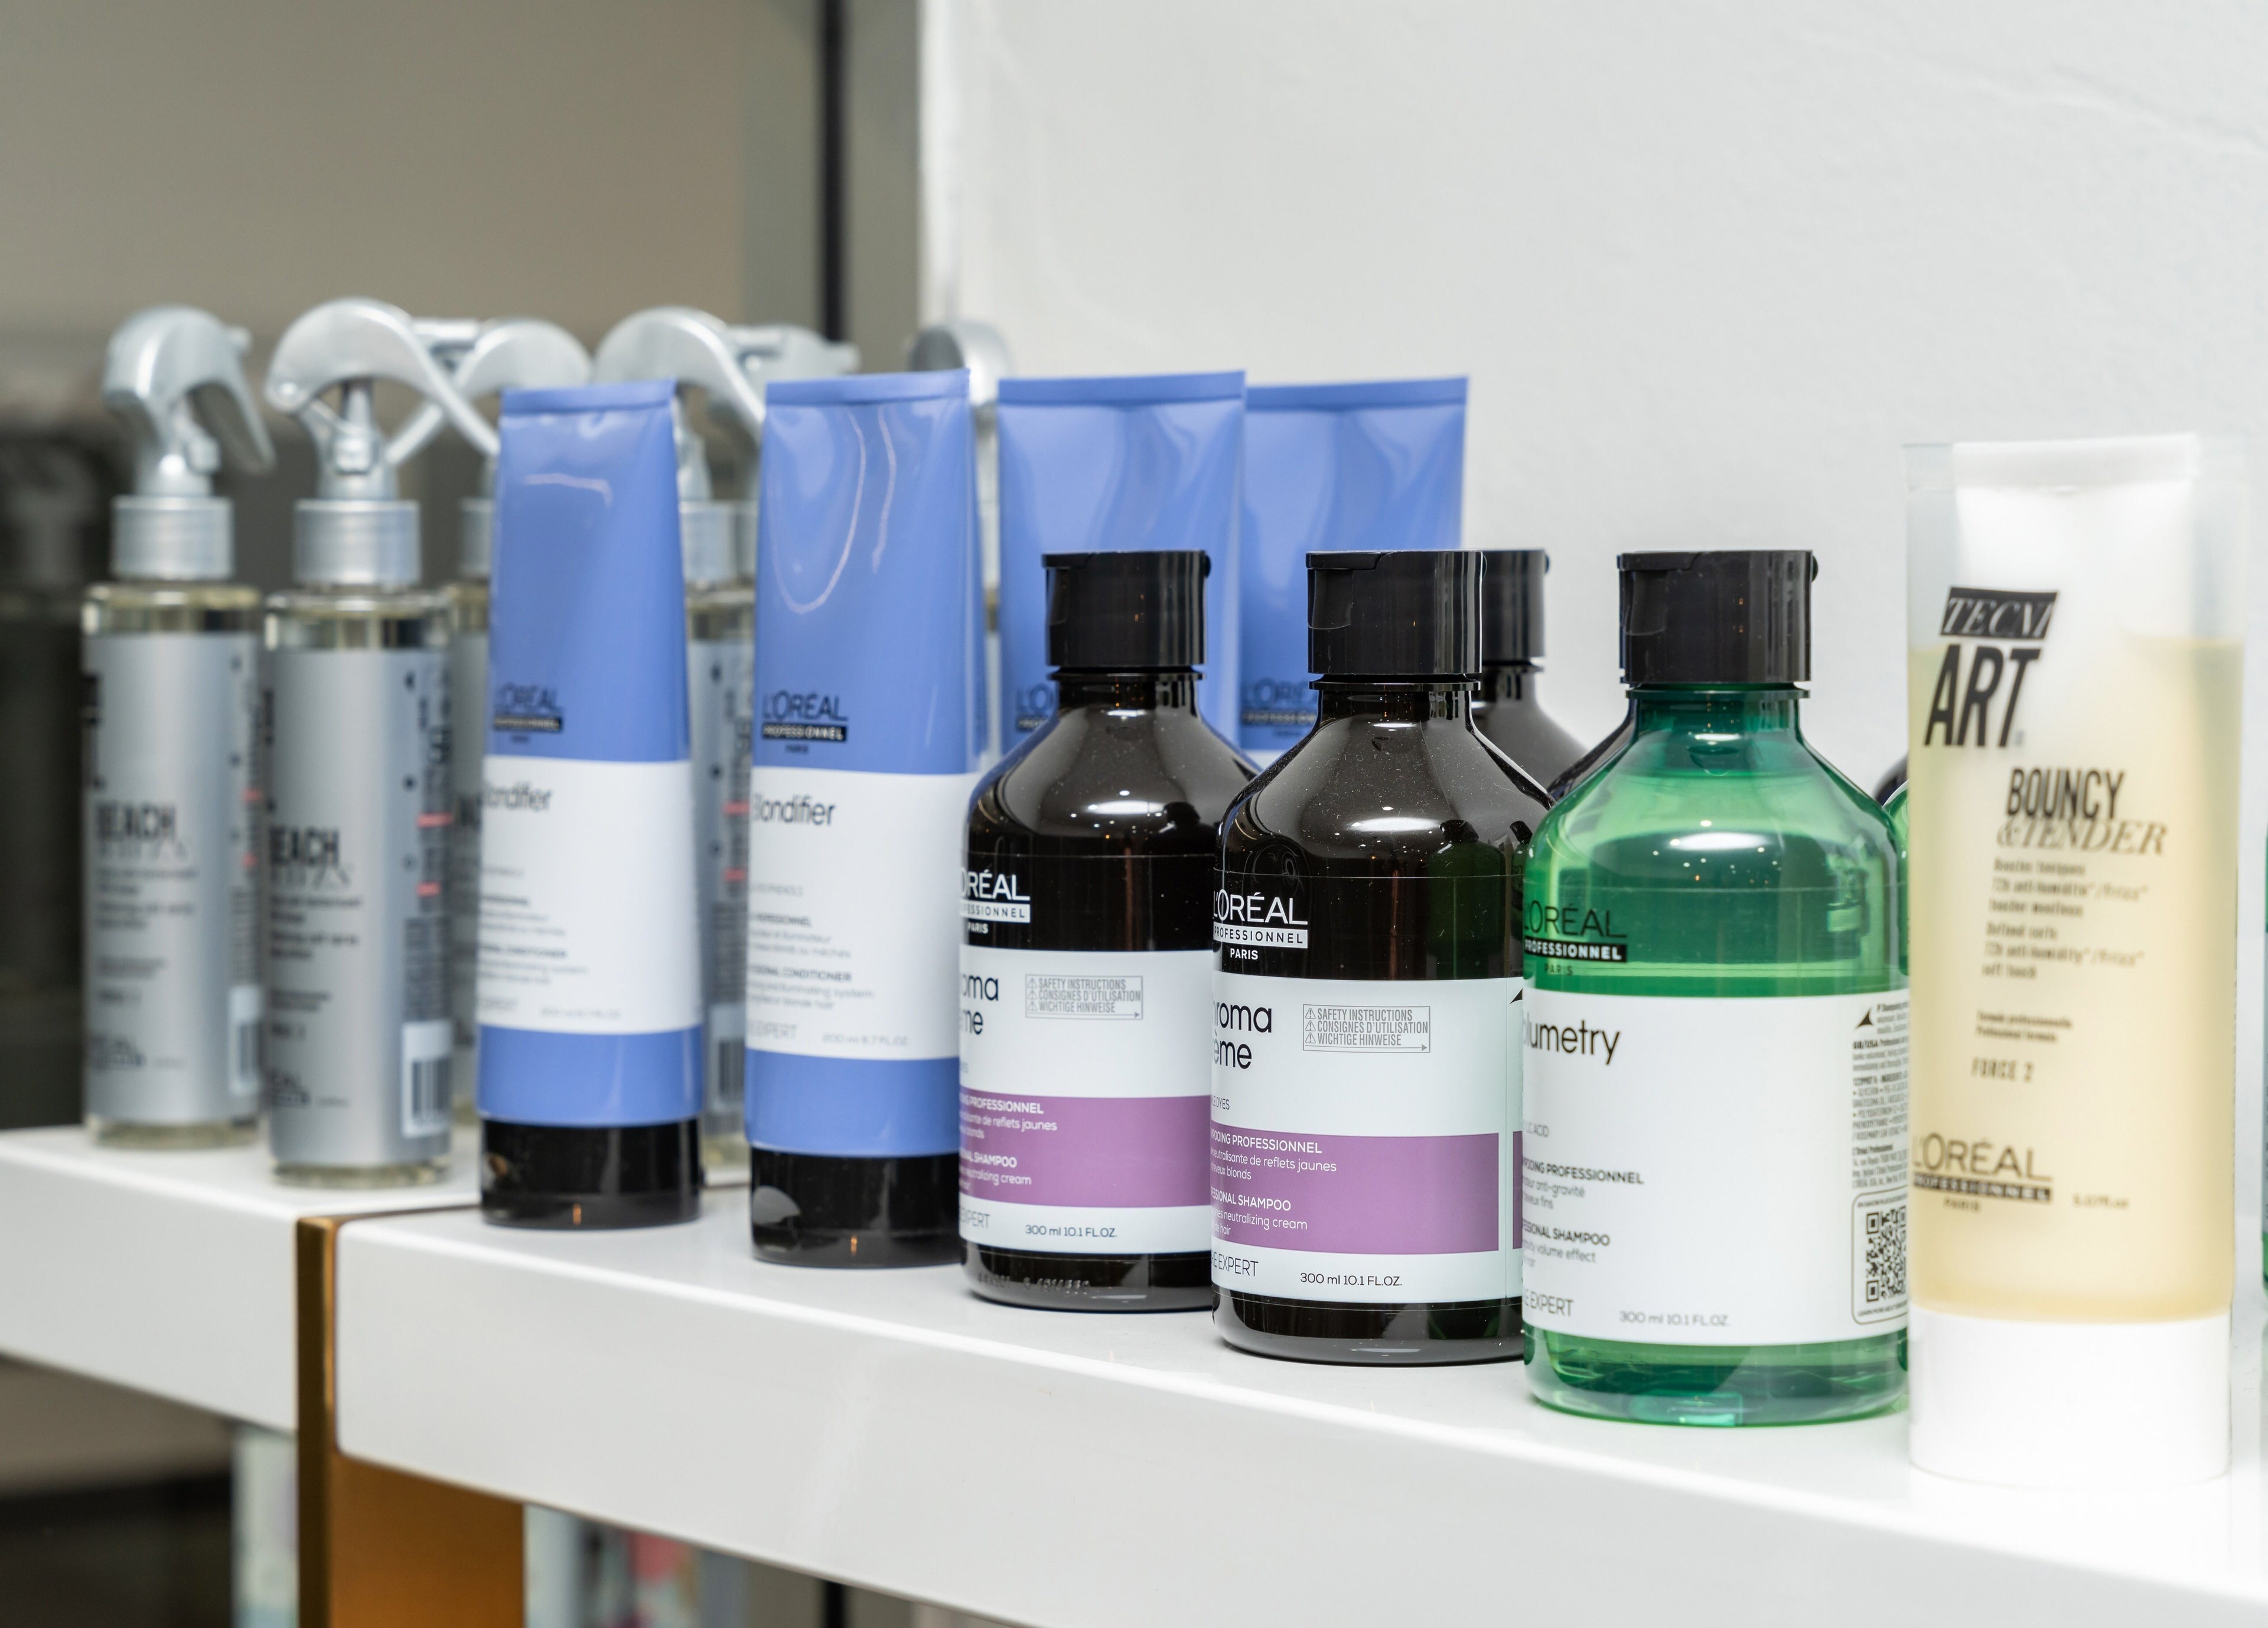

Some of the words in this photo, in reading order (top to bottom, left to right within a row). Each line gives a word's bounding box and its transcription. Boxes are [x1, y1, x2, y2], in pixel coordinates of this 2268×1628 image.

[1943, 597, 2055, 638] TECNI
[1923, 643, 2042, 748] ART
[2006, 767, 2125, 820] BOUNCY
[1213, 888, 1308, 926] L'ORÉAL
[1214, 925, 1304, 945] PROFESSIONNEL
[1230, 948, 1259, 960] PARIS
[1038, 978, 1067, 989] SAFETY
[1067, 978, 1126, 991] INSTRUCTIONS
[1038, 989, 1081, 1001] CONSIGNES
[1083, 989, 1141, 1002] D'UTILISATION
[1038, 1001, 1074, 1012] WICHTIGE
[1077, 1001, 1116, 1014] HINWEISE
[1318, 1008, 1347, 1021] SAFETY
[1349, 1009, 1413, 1022] INSTRUCTIONS
[1318, 1020, 1364, 1034] CONSIGNES
[1318, 1033, 1358, 1046] WICHTIGE
[1359, 1034, 1402, 1046] HINWEISE
[1212, 1028, 1252, 1070] ème
[1216, 1097, 1230, 1111] DYES
[1021, 1118, 1058, 1132] jaunes
[1232, 1135, 1322, 1154] PROFESSIONNEL
[973, 1151, 1018, 1168] SHAMPOO
[1250, 1154, 1261, 1167] de
[1263, 1156, 1296, 1170] reflets
[1296, 1158, 1337, 1173] jaunes
[1001, 1174, 1032, 1186] cream
[1227, 1166, 1252, 1180] blonds
[1546, 1163, 1644, 1185] PROFESSIONNEL
[1238, 1194, 1292, 1212] SHAMPOO
[1224, 1210, 1270, 1230] neutralizing
[1272, 1219, 1308, 1230] cream
[1025, 1225, 1047, 1236] 300
[1048, 1226, 1061, 1236] ml
[1220, 1225, 1231, 1236] hair
[1552, 1227, 1611, 1246] SHAMPOO
[1218, 1253, 1259, 1277] EXPERT
[1300, 1272, 1324, 1284] 300
[1327, 1274, 1341, 1285] ml
[1343, 1275, 1364, 1286] 10.1
[1367, 1276, 1403, 1287] FL.OZ.
[1530, 1291, 1574, 1317] EXPERT
[1619, 1310, 1647, 1324] 300
[1648, 1314, 1664, 1325] ml
